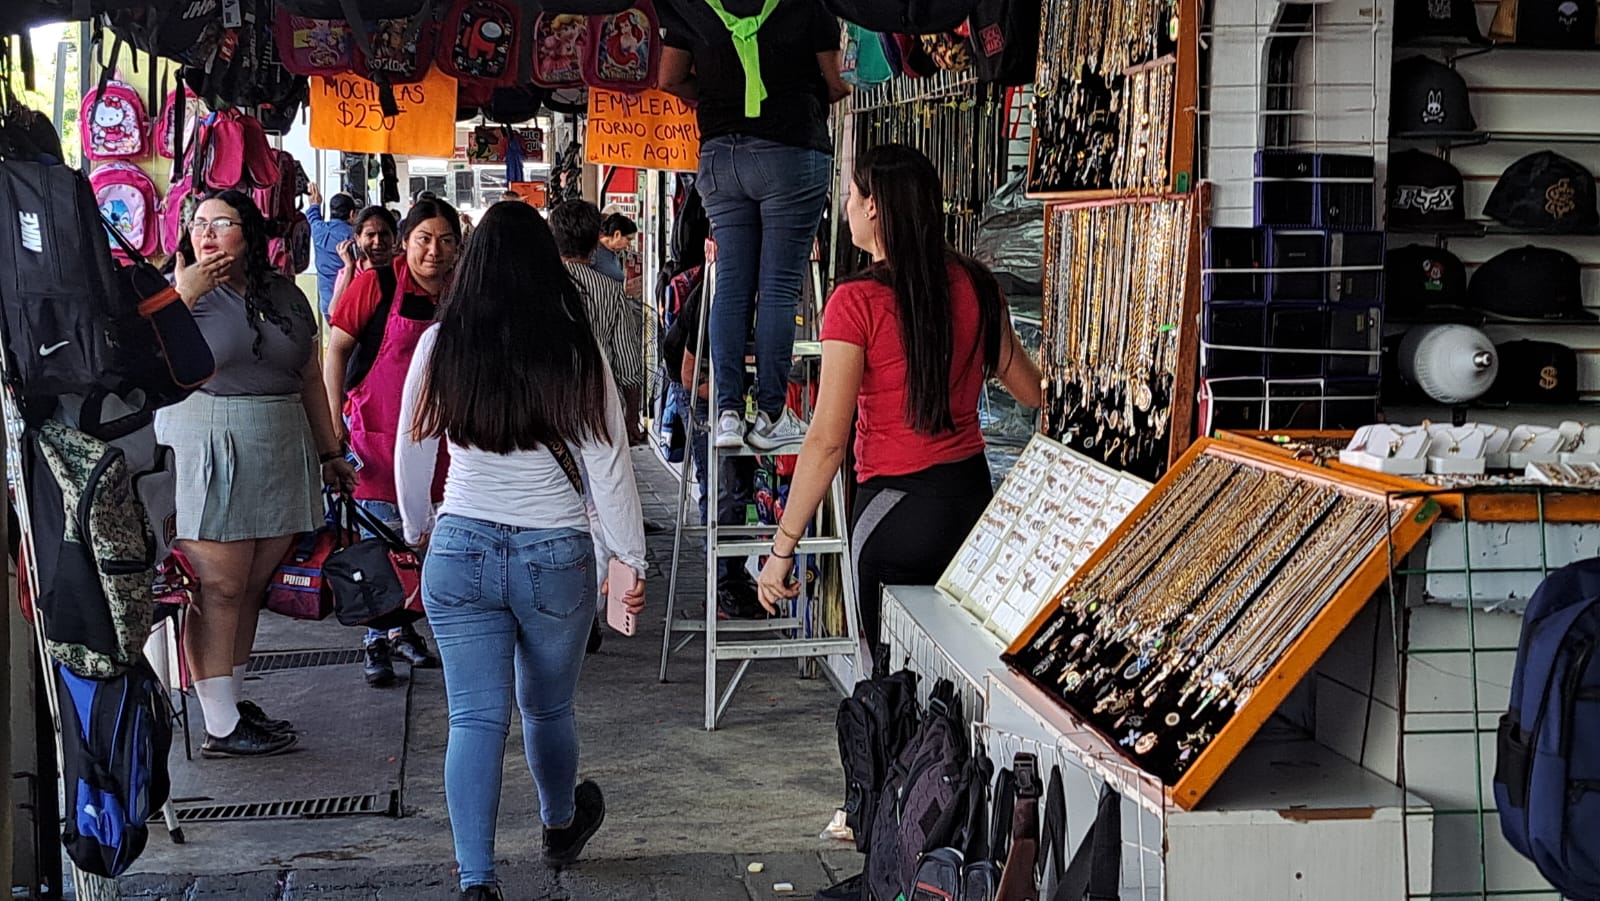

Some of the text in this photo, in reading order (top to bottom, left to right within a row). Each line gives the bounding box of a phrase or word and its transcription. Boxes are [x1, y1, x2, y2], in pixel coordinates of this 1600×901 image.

[324, 78, 425, 104] MOCHAS
[590, 118, 647, 137] TURNO
[601, 142, 632, 159] INF.
[18, 210, 43, 253] NIKE
[282, 573, 311, 588] PUMA
